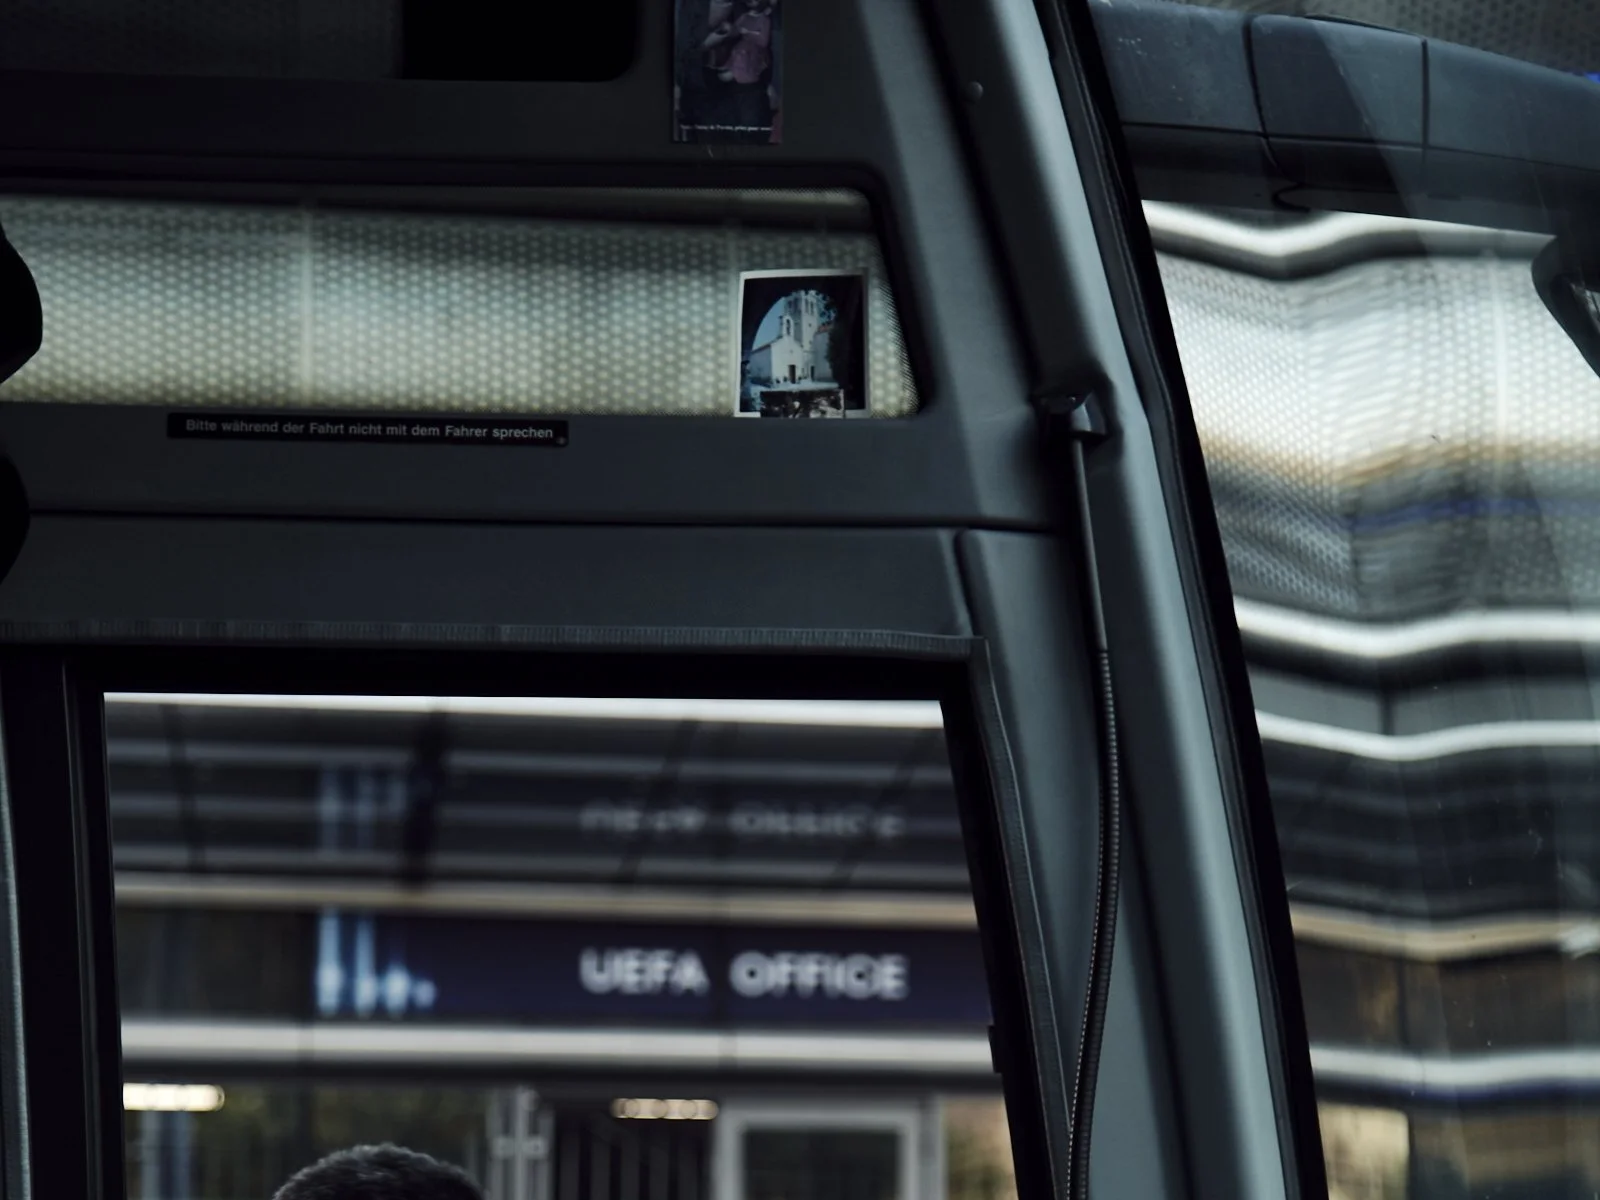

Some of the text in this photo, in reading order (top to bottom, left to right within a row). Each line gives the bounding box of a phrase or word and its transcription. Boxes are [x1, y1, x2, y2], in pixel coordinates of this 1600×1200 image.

[185, 418, 553, 440] Bitte während der Fahrt nicht mit dem Fahrer sprechen
[579, 946, 910, 1000] UEFA OFFICE
